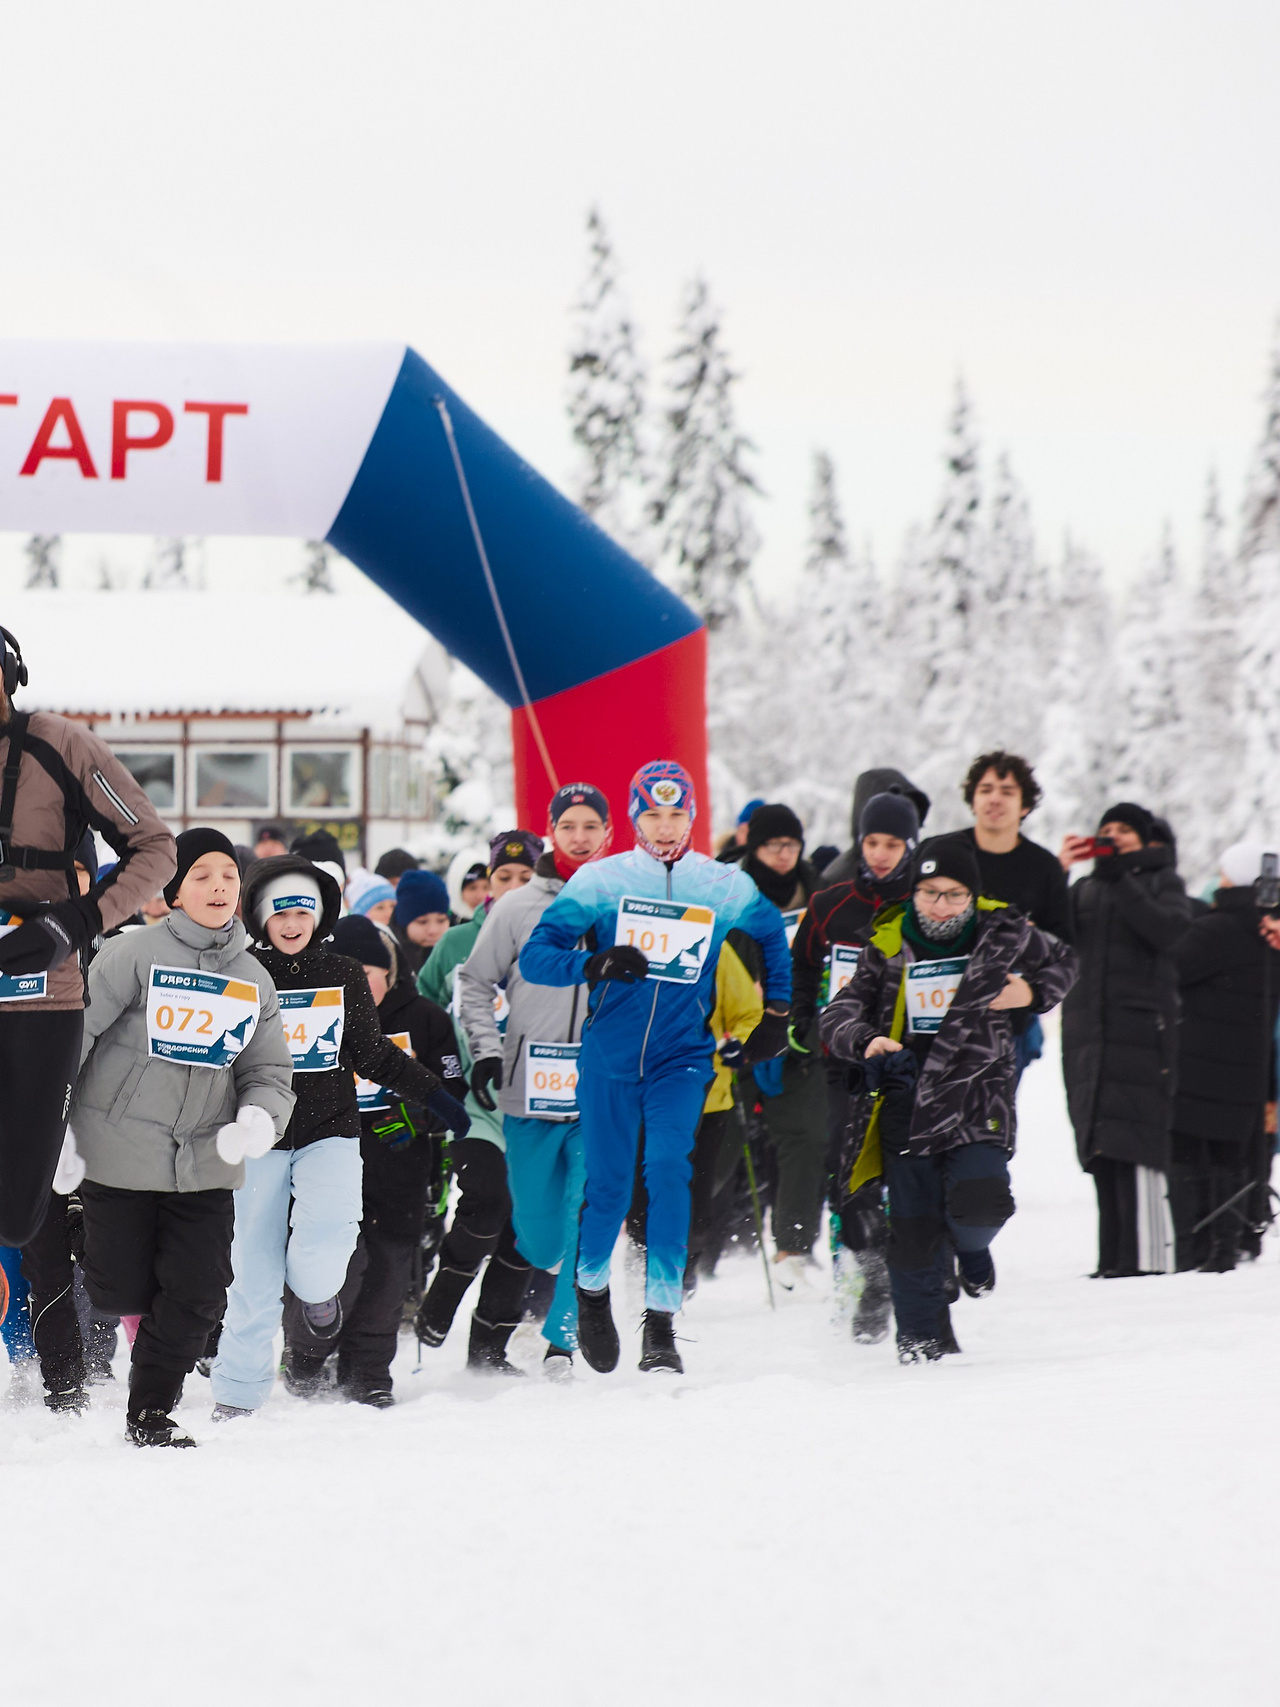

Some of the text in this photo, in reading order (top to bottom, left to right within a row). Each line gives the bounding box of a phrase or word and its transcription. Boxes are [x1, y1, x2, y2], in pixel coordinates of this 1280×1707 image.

[626, 929, 668, 954] 101
[155, 1005, 214, 1035] 072
[157, 1042, 209, 1055] КОВДОРСКИЙ
[533, 1071, 577, 1091] 084
